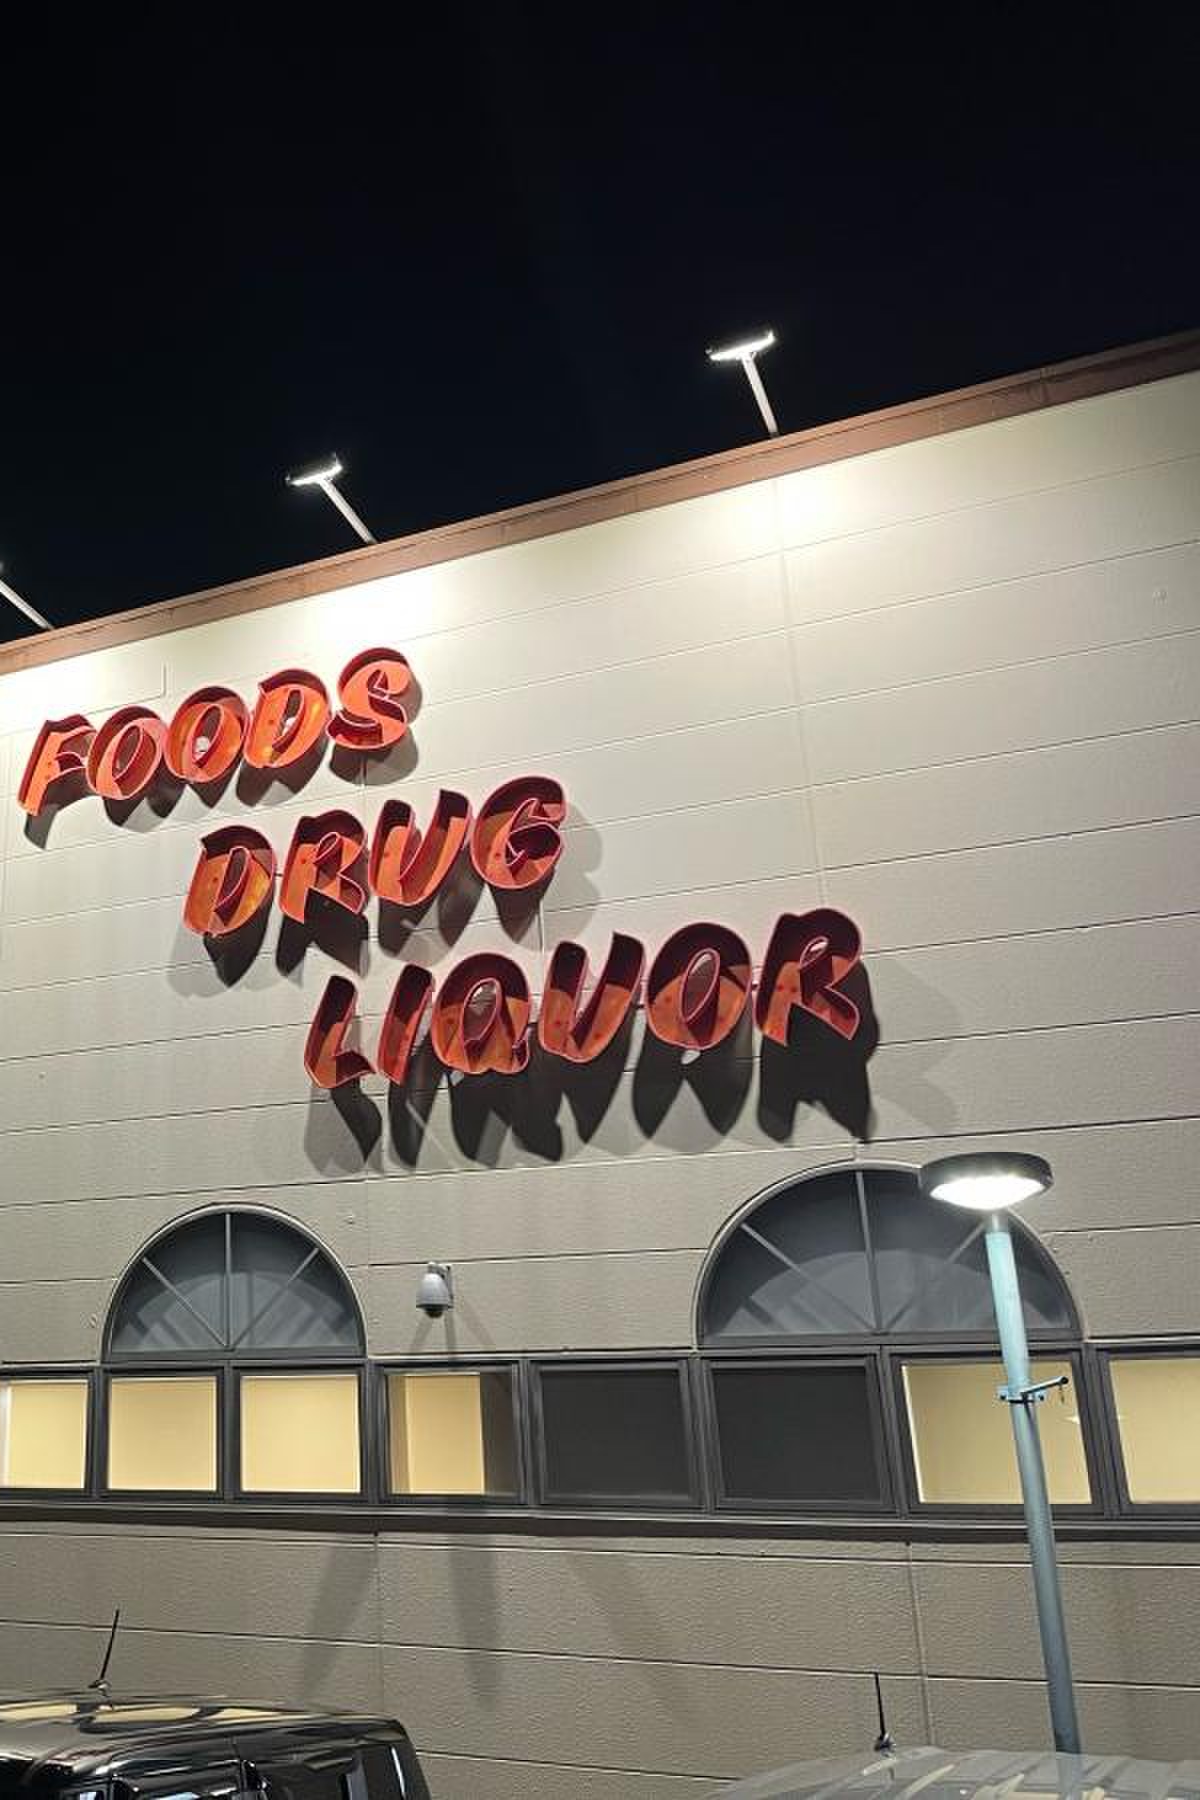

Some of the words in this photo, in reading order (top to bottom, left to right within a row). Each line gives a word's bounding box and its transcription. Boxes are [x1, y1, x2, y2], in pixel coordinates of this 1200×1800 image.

[17, 646, 414, 817] FOODS
[183, 775, 567, 938] DRUG
[303, 906, 864, 1090] LIQUOR
